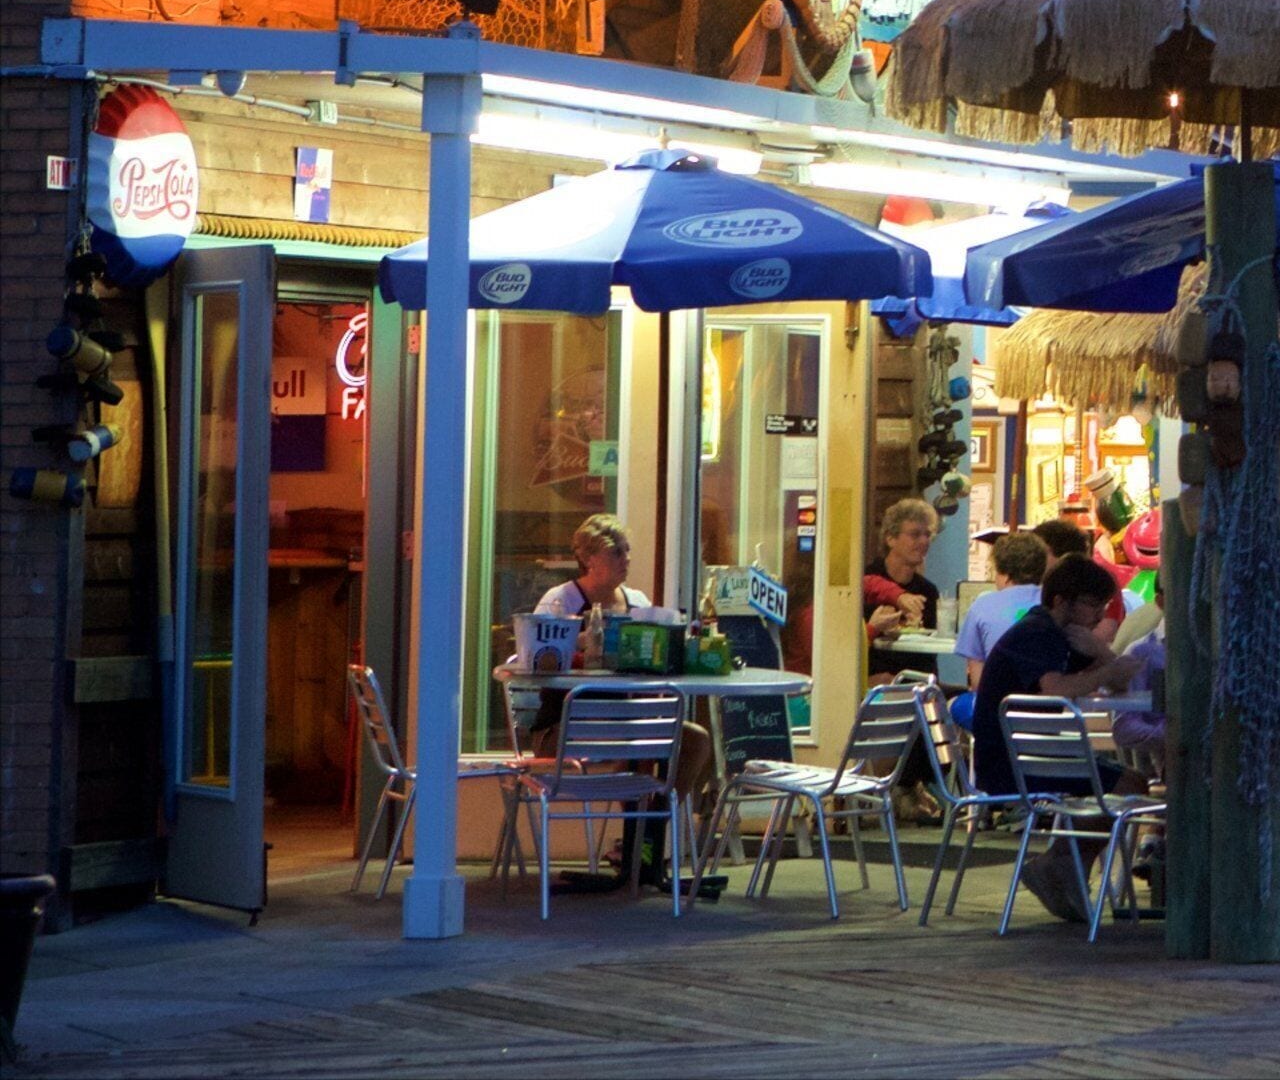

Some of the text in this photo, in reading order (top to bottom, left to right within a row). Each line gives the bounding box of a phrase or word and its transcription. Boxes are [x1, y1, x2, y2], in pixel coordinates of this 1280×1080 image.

[702, 218, 781, 229] BUD
[691, 226, 798, 239] LIGHT
[495, 272, 526, 282] BUD
[748, 267, 783, 277] BUD
[487, 281, 527, 292] LIGHT
[742, 276, 787, 287] LIGHT
[273, 370, 306, 398] ull
[751, 577, 784, 617] OPEN
[536, 622, 571, 642] Lite
